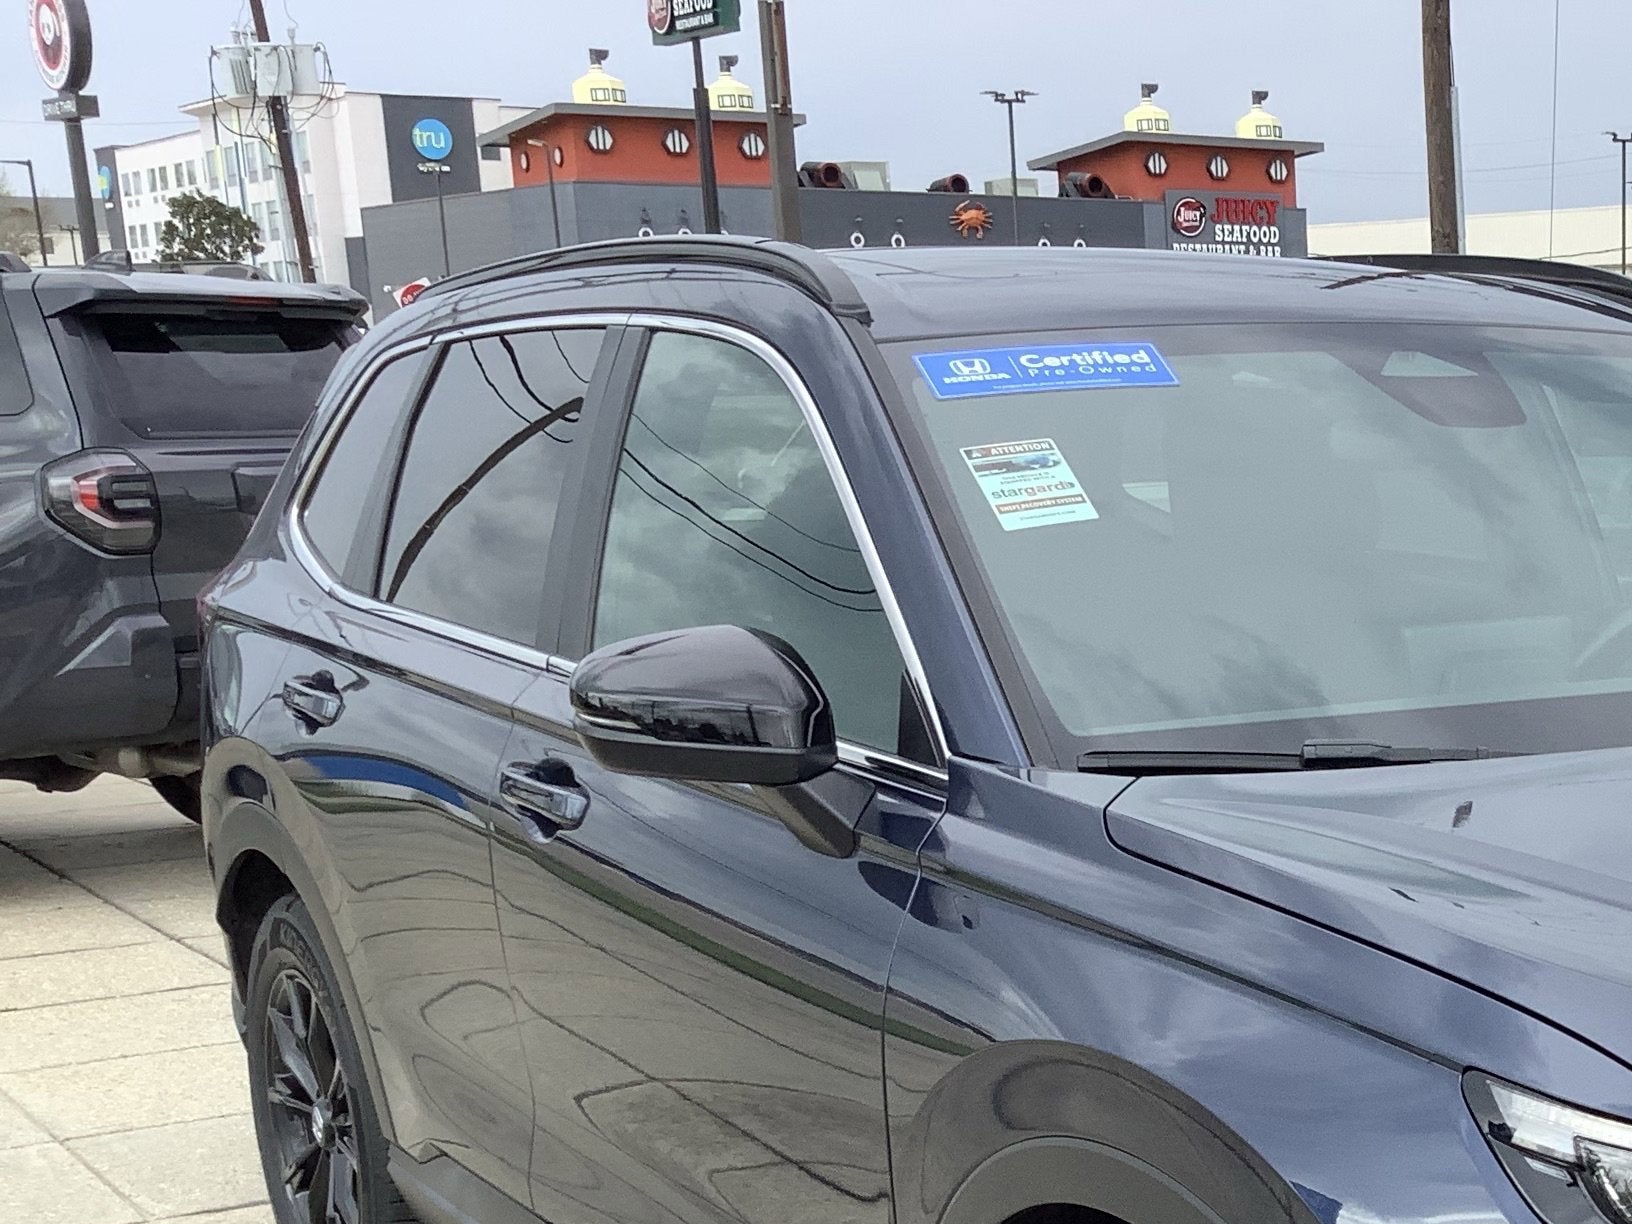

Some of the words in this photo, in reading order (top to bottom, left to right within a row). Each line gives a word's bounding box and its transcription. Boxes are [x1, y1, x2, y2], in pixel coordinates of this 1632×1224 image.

[412, 127, 446, 149] tru
[1209, 197, 1279, 225] JUICY
[1215, 223, 1280, 243] SEAFOOD
[1019, 349, 1151, 368] Certified
[943, 372, 1012, 384] HONDA
[1028, 363, 1157, 377] Pre-Owned
[990, 441, 1050, 456] ATTENTION
